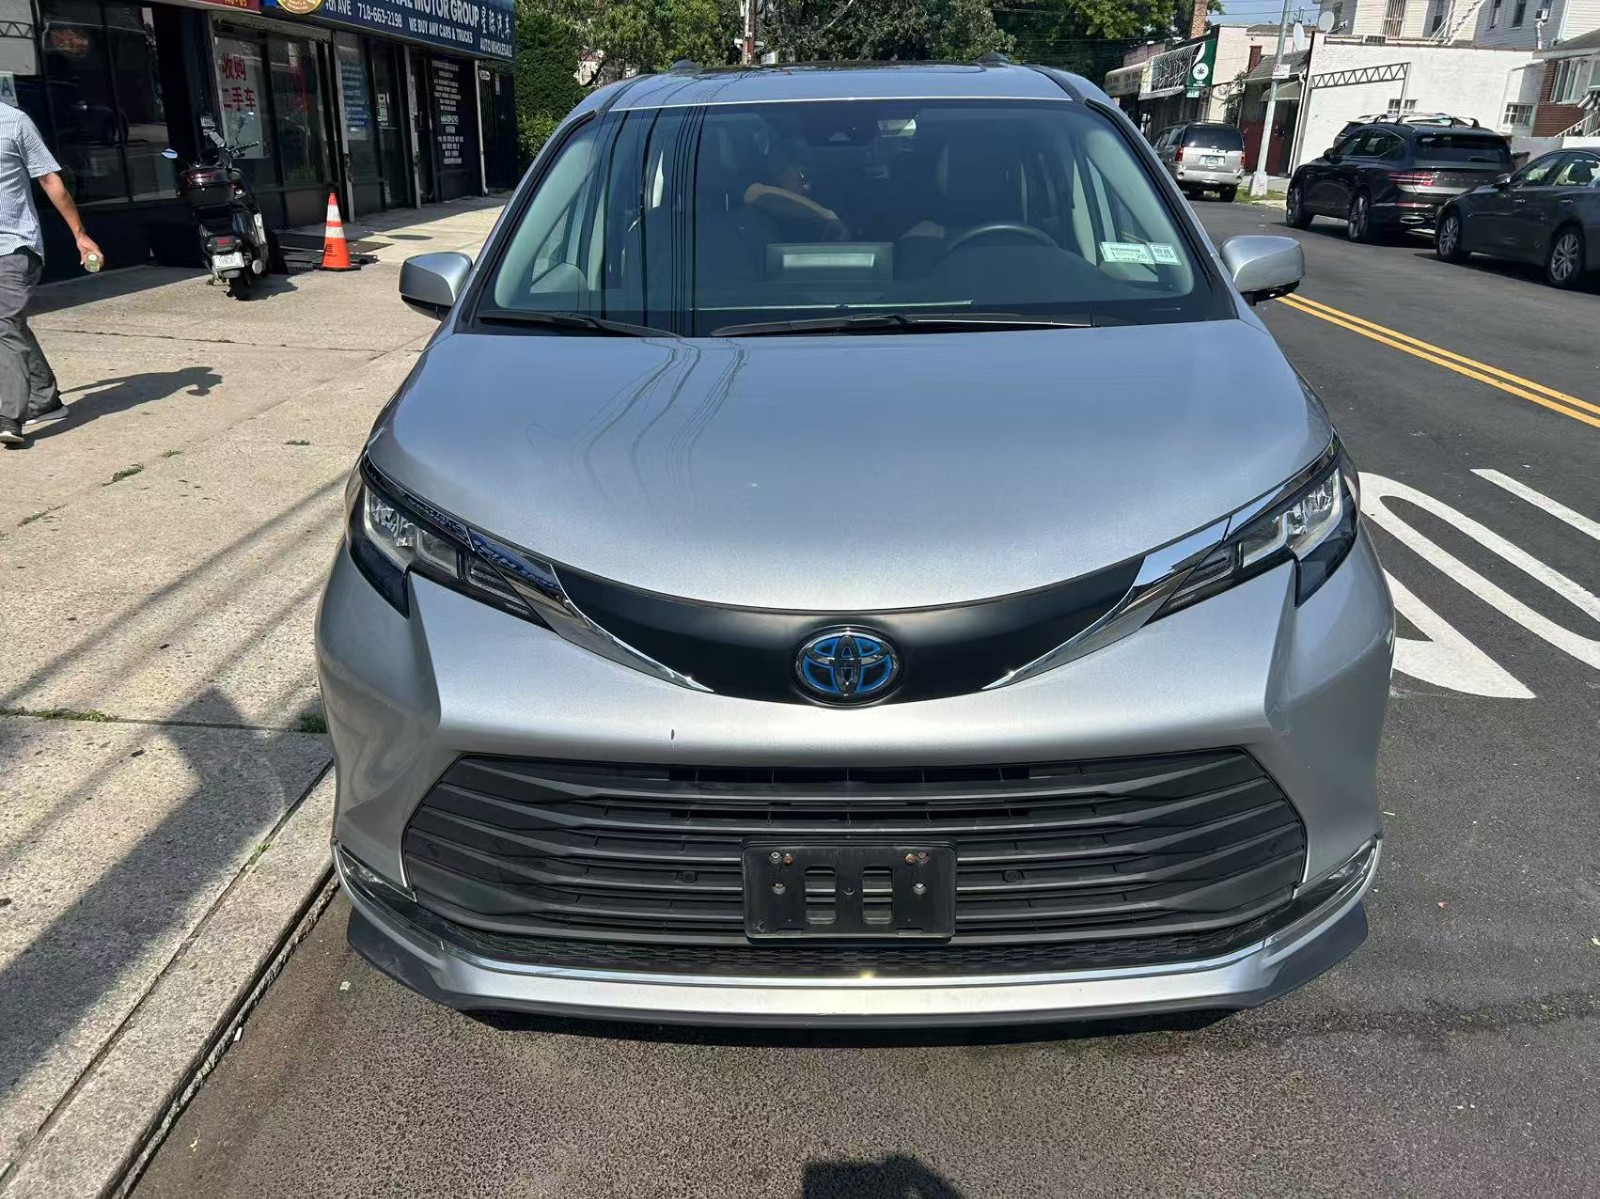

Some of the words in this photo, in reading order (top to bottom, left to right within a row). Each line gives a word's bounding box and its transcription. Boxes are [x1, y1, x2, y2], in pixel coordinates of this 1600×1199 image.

[337, 0, 352, 16] AVE
[357, 3, 403, 28] 718-663-2198
[450, 0, 479, 28] GROUP
[408, 16, 418, 32] WE
[417, 18, 428, 34] BUY
[428, 21, 439, 37] ANY
[438, 23, 452, 39] CARS
[455, 28, 473, 44] TRUCKS
[221, 86, 257, 112] 二手车
